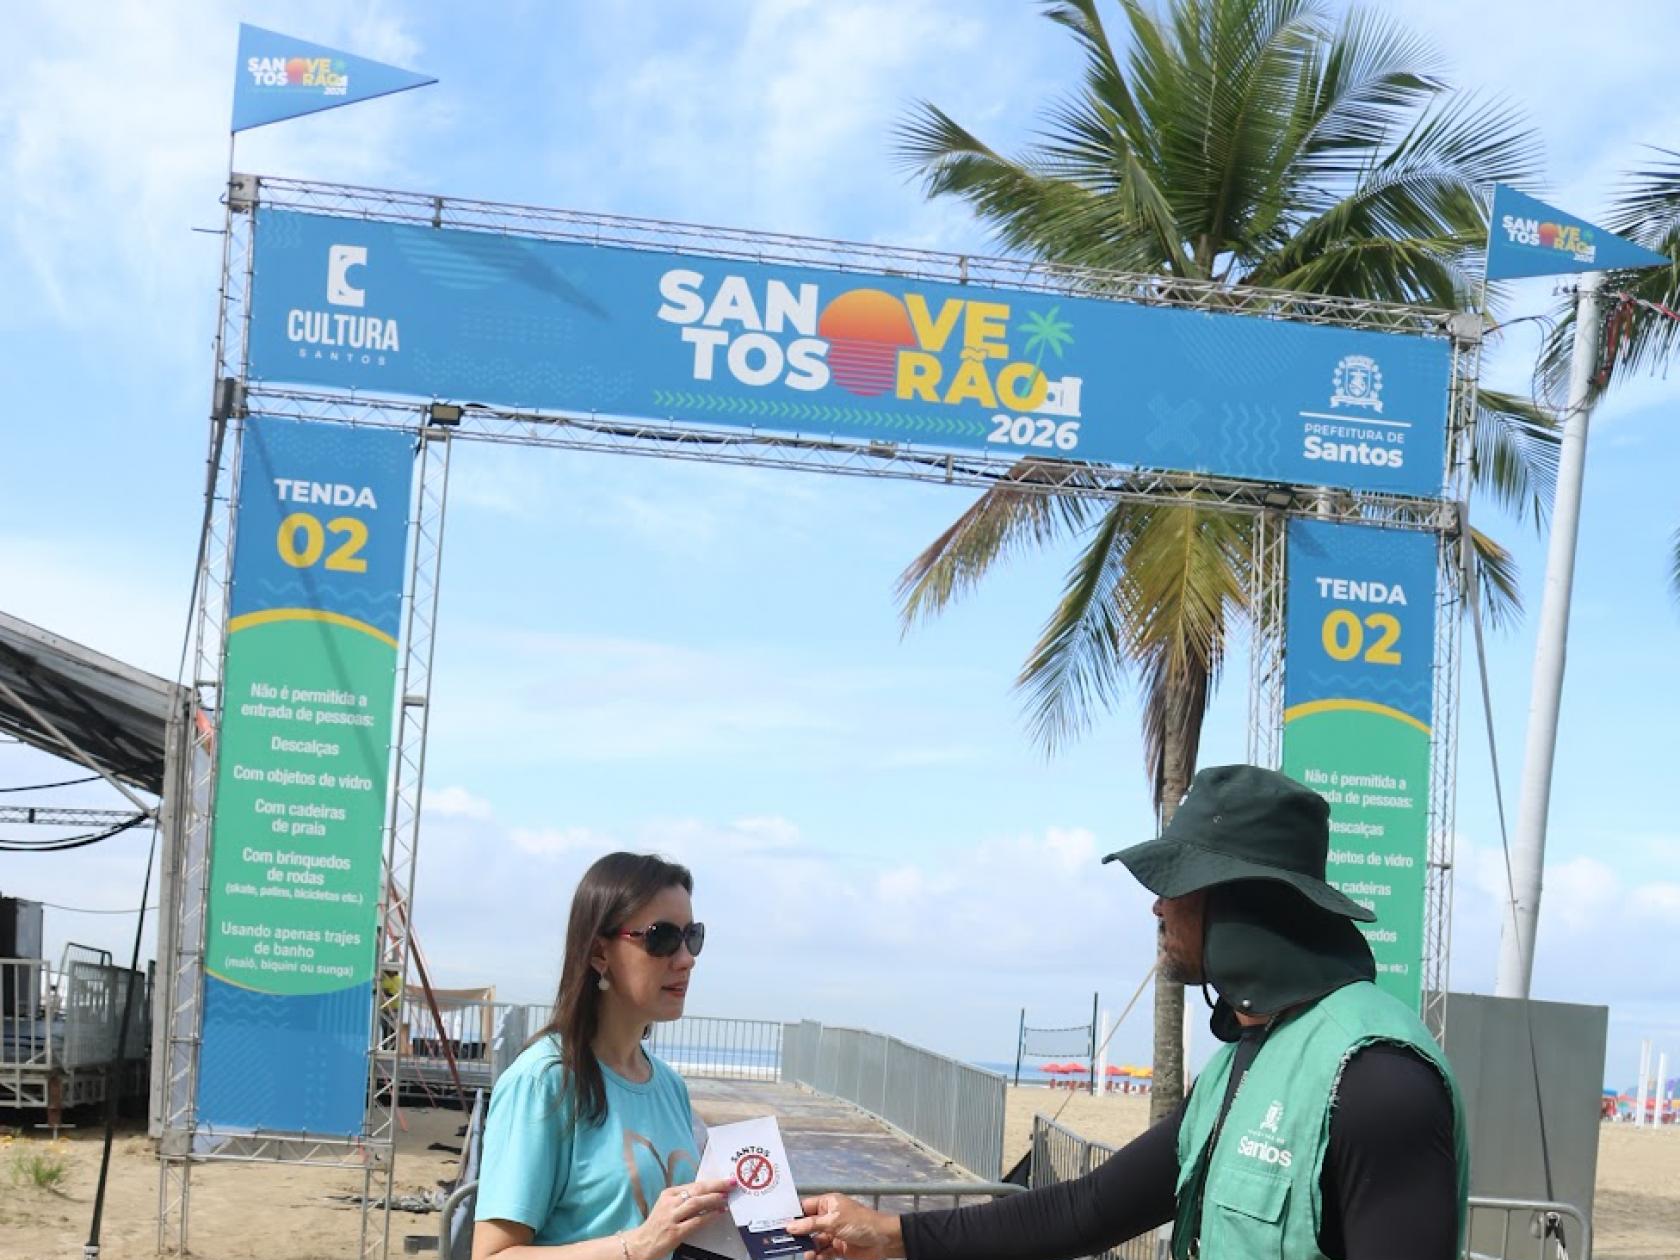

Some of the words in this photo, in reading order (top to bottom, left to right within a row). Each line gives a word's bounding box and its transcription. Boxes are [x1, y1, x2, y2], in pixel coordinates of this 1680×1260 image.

[248, 57, 286, 72] SAN
[253, 71, 289, 86] TOS
[1502, 214, 1539, 232] SAN
[1507, 229, 1540, 246] TOS
[657, 269, 819, 336] SAN
[288, 309, 400, 351] CULTURA
[904, 293, 1010, 359] VE
[299, 348, 386, 366] SANTOS
[681, 326, 830, 391] TOS
[896, 346, 1049, 413] RÃO
[987, 414, 1081, 450] 2026
[1304, 422, 1384, 441] PREFEITURA
[1386, 431, 1405, 444] DE
[1303, 435, 1404, 468] Santos
[274, 478, 378, 510] TENDA
[277, 512, 369, 573] 02
[1316, 576, 1408, 606] TENDA
[1321, 608, 1402, 665] 02
[250, 682, 277, 699] Não
[280, 685, 289, 700] é
[291, 688, 356, 706] permitida
[358, 694, 368, 707] a
[241, 702, 292, 719] entrada
[296, 706, 312, 721] de
[315, 712, 375, 727] pessoas:
[271, 735, 340, 757] Descalças
[233, 764, 264, 781] Com
[267, 768, 315, 786] objetos
[319, 772, 335, 787] de
[339, 775, 373, 791] vidro
[1305, 769, 1328, 784] Não
[1330, 771, 1338, 785] é
[1340, 774, 1397, 790] permitida
[1399, 779, 1407, 791] a
[1345, 790, 1360, 804] de
[255, 798, 285, 815] Com
[288, 803, 346, 821] cadeiras
[271, 818, 288, 834] de
[291, 820, 326, 837] praia
[242, 847, 273, 863] Com
[276, 850, 352, 871] brinquedos
[1327, 849, 1364, 866] bjetos
[1367, 852, 1381, 865] de
[1384, 853, 1414, 867] vidro
[267, 868, 283, 882] de
[286, 870, 325, 886] rodas
[1342, 881, 1391, 896] cadeiras
[222, 921, 271, 938] Usando
[274, 926, 321, 942] apenas
[324, 929, 361, 947] trajes
[254, 941, 270, 956] de
[273, 942, 315, 959] banho
[300, 963, 314, 974] ou
[316, 963, 354, 979] sunga)
[1237, 1135, 1292, 1168] Santos
